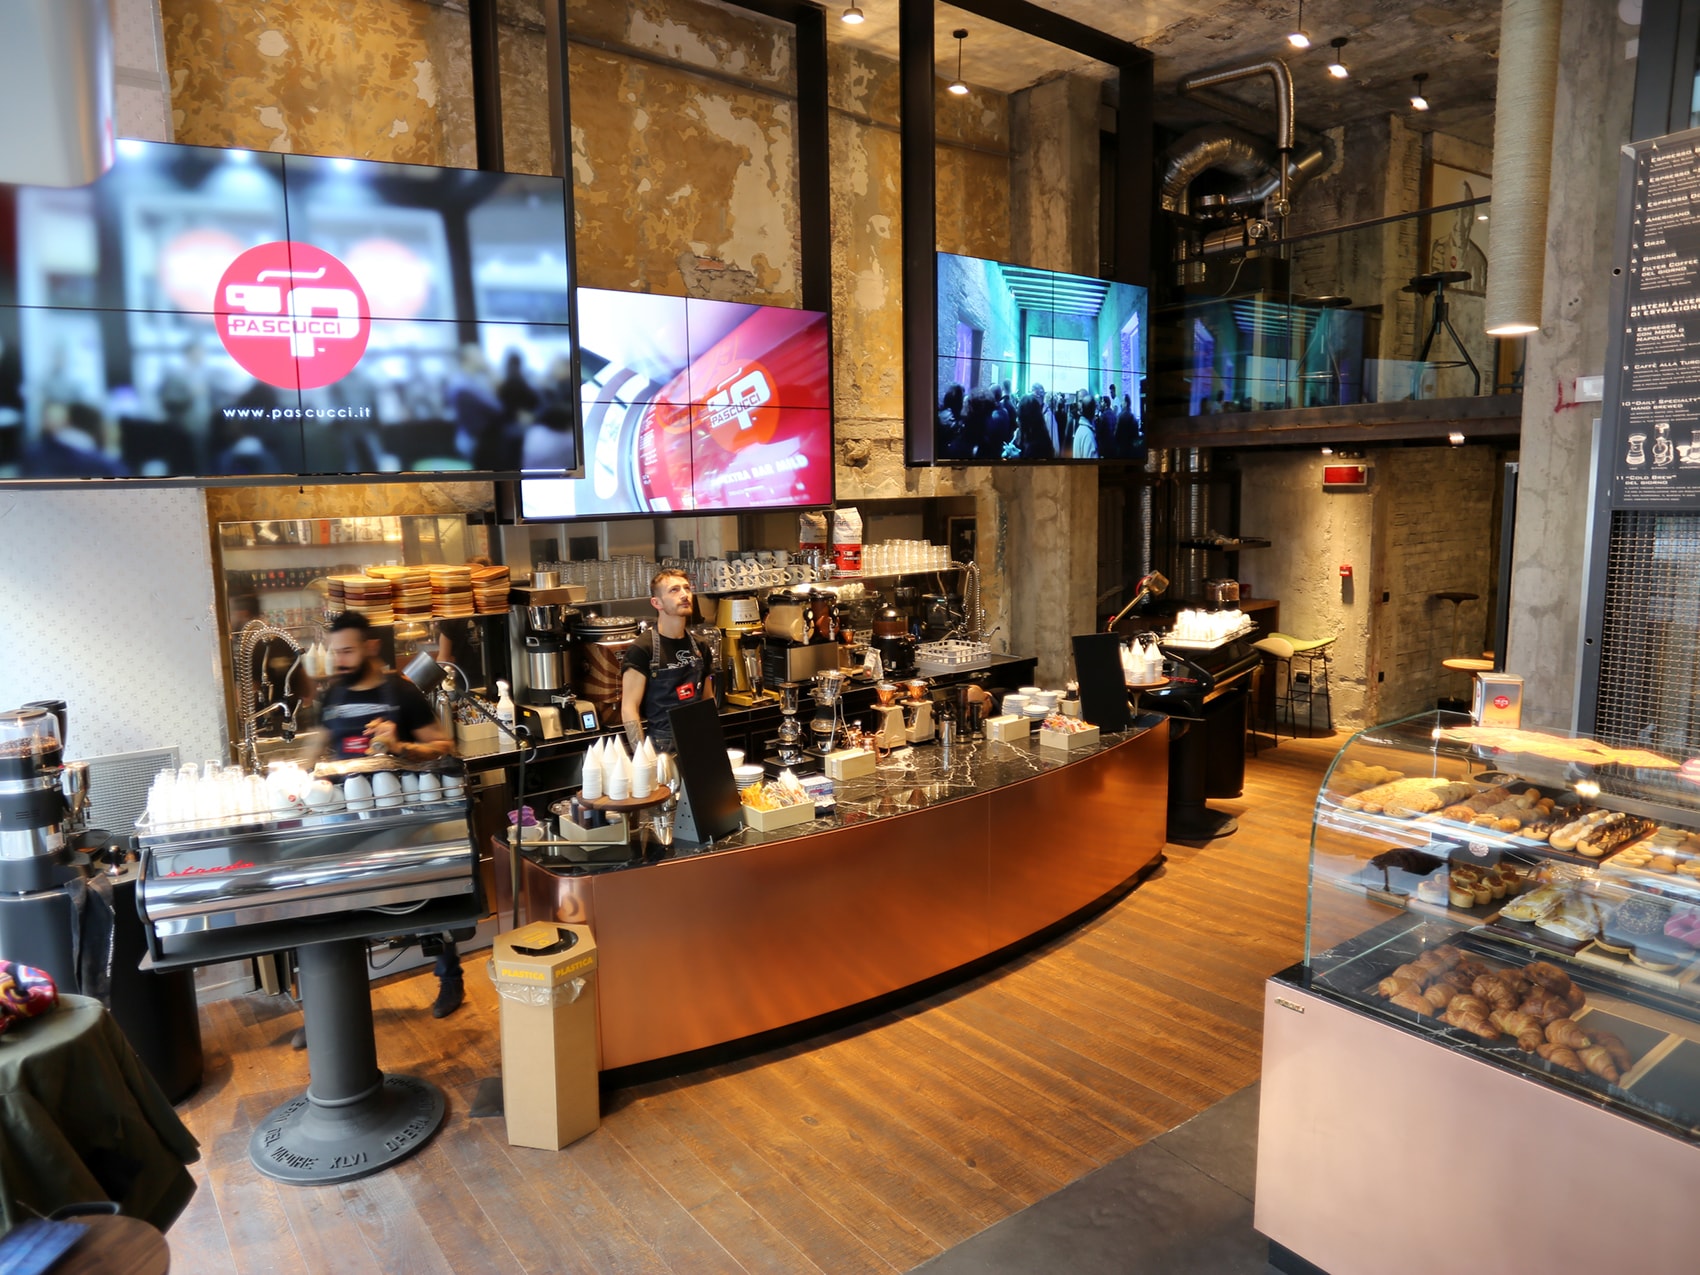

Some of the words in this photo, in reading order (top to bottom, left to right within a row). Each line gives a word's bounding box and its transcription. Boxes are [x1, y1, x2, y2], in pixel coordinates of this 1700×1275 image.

[1651, 150, 1693, 163] ESPRESSO
[1649, 170, 1690, 183] ESPRESSO
[1647, 195, 1688, 208] ESPRESSO
[1645, 210, 1690, 223] AMERICANO
[1644, 239, 1666, 247] ORZO
[1642, 252, 1677, 262] GINSENG
[1642, 264, 1666, 272] FILTER
[1668, 259, 1698, 268] COFFEE
[1658, 266, 1687, 275] GIORNO
[1631, 302, 1669, 311] SISTEMI
[233, 318, 341, 335] PASCUCCI
[1637, 323, 1677, 332] ESPRESSO
[1636, 333, 1685, 342] NAPOLETANA
[223, 407, 371, 421] www.pascucci.it
[711, 391, 762, 426] PASCUCCI
[554, 956, 593, 978] PLASTICA
[501, 968, 545, 981] PLASTICA
[328, 1152, 368, 1169] XLVI
